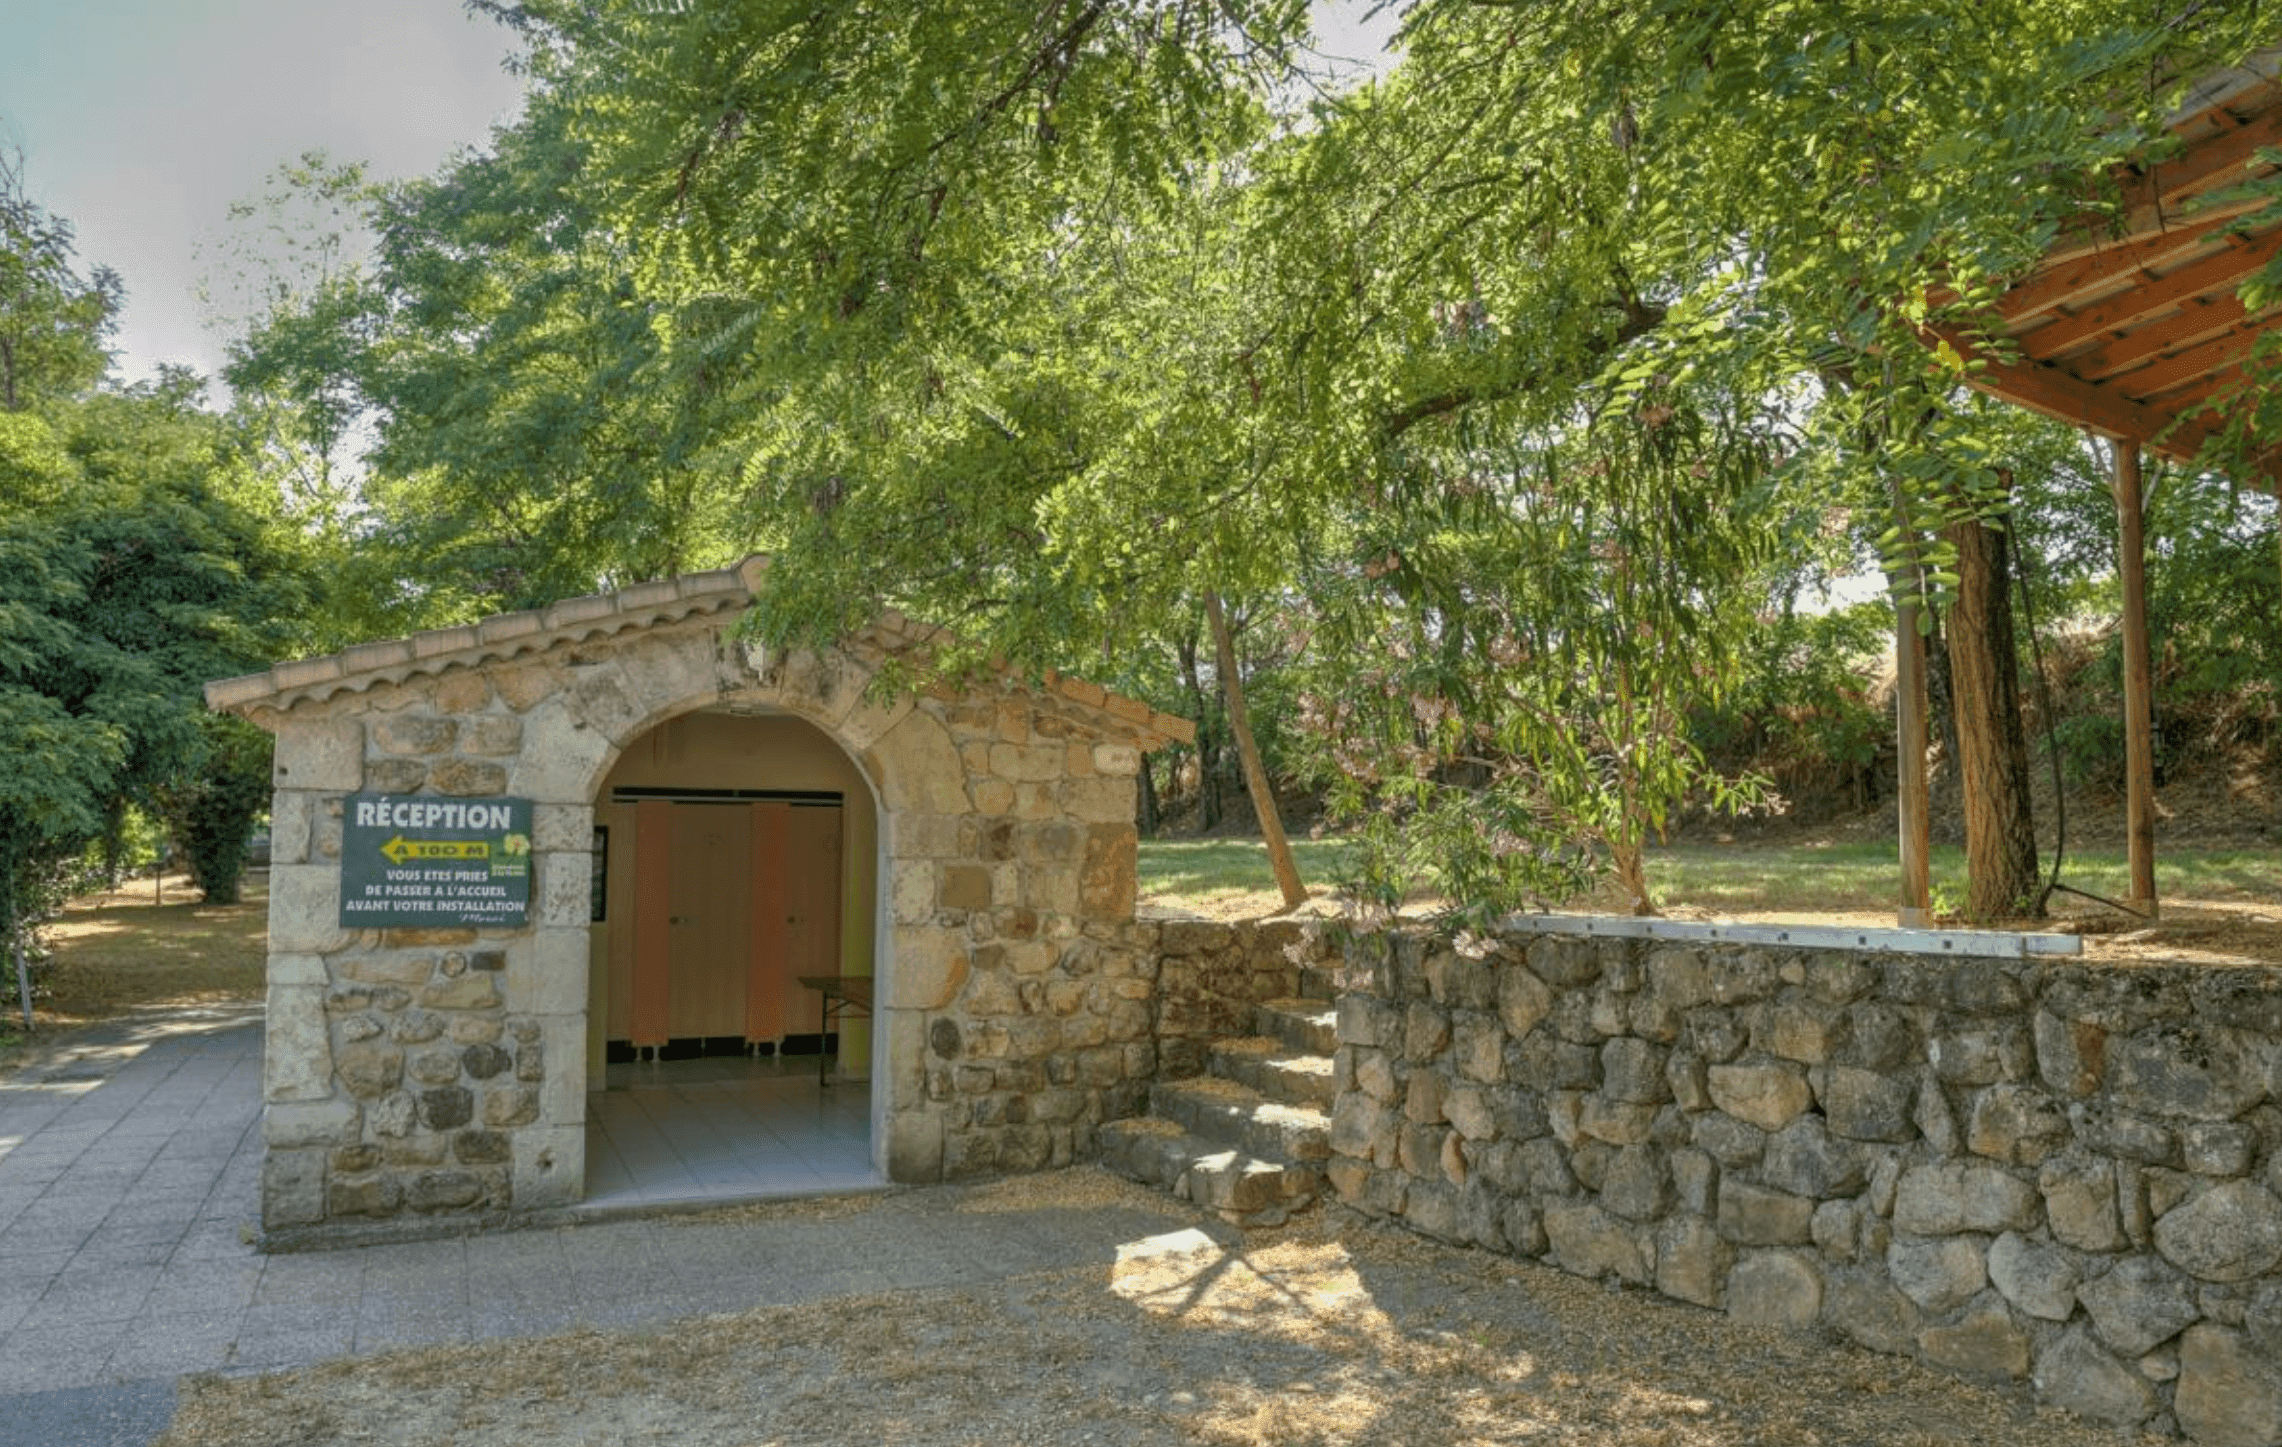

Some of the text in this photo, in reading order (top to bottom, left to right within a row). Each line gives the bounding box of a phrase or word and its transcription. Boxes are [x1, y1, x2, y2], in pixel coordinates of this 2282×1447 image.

[357, 797, 511, 829] RÉCEPTION
[419, 844, 457, 855] 100
[387, 869, 420, 881] VOUS
[365, 885, 382, 896] DE
[385, 885, 431, 896] PASSER
[448, 885, 506, 897] L'ACCUEIL
[346, 900, 525, 911] AVANT VOTRE INSTALLATION
